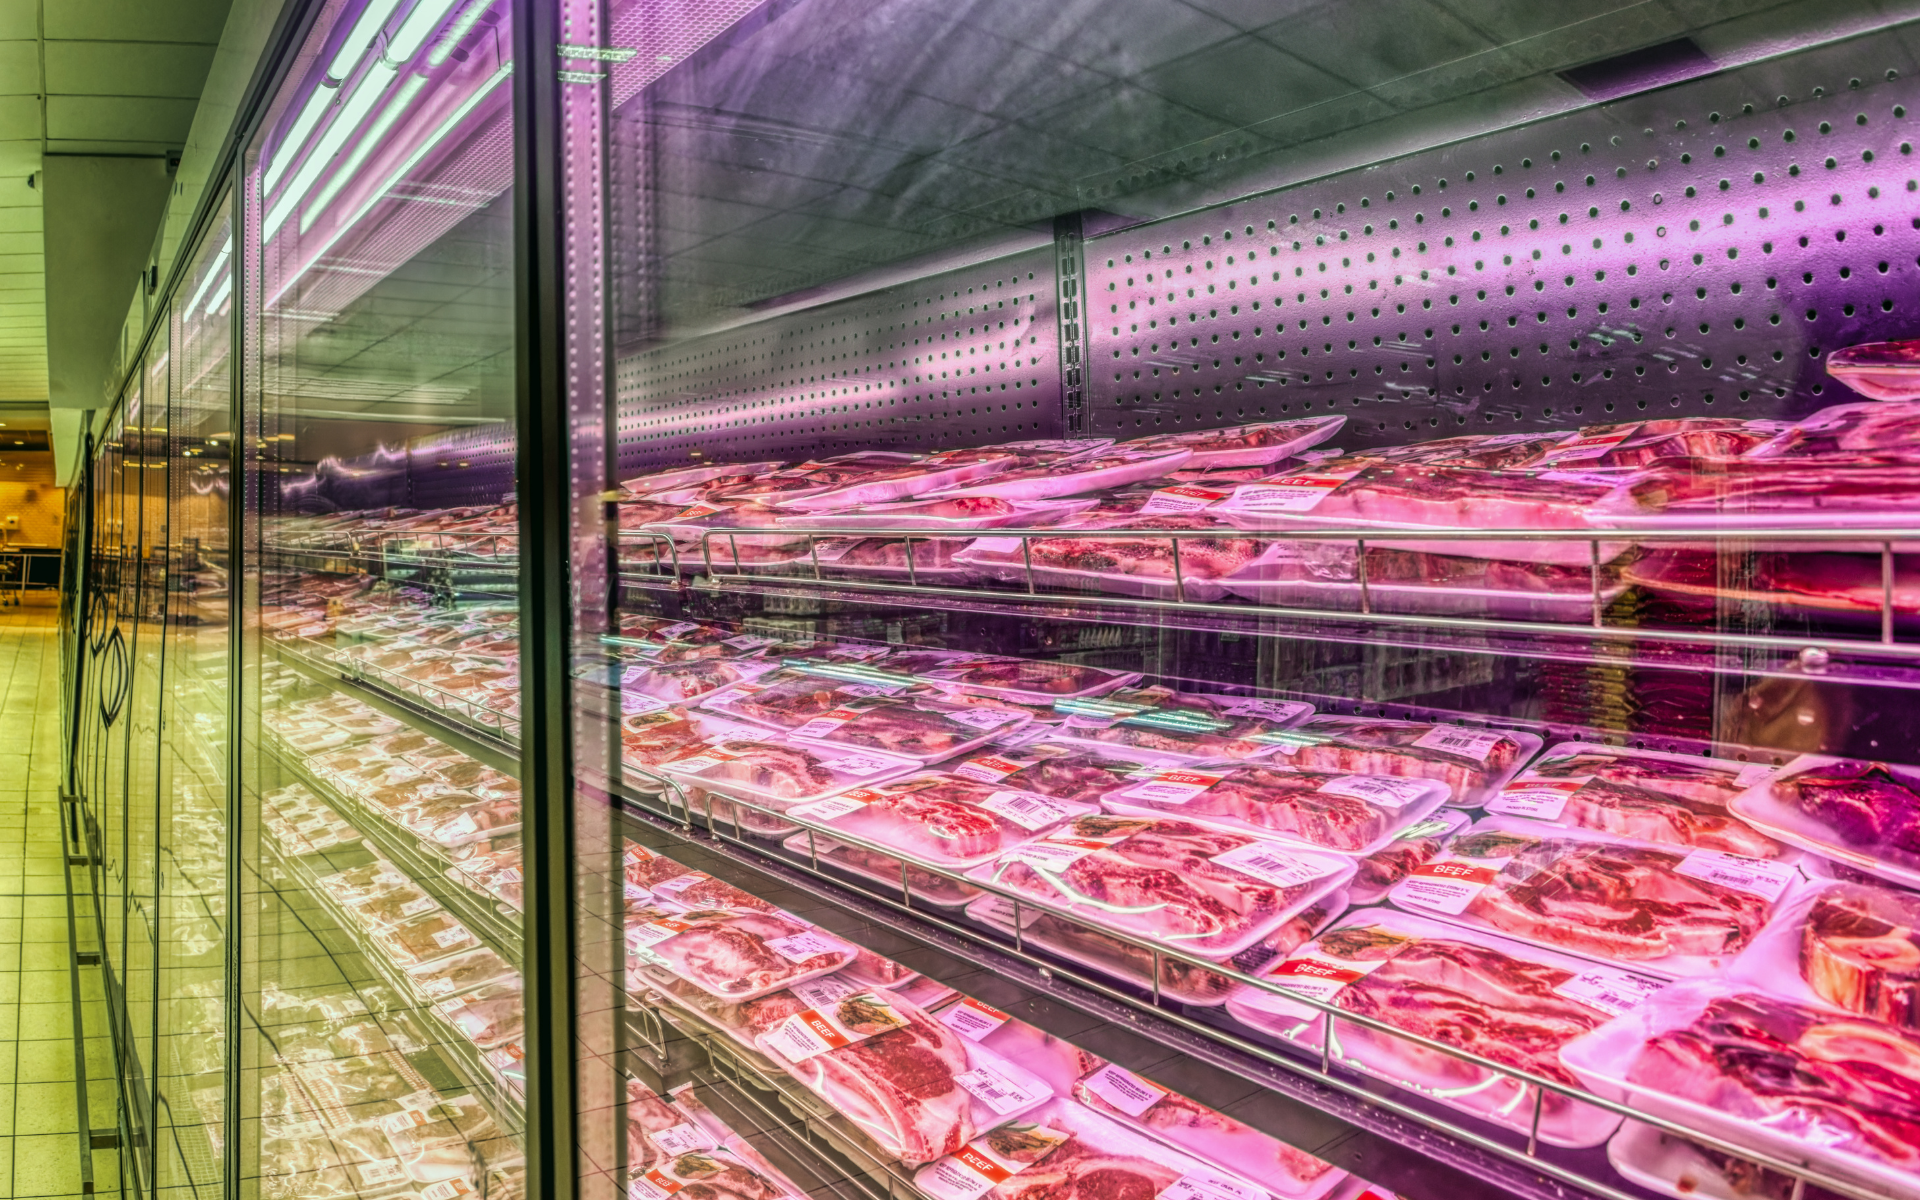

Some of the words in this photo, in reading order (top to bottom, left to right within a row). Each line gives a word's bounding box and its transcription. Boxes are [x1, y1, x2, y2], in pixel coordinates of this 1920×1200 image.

[1167, 774, 1201, 782] BEEF
[1433, 864, 1474, 876] BEEF
[1294, 963, 1337, 976] BEEF
[811, 1020, 836, 1038] BEEF
[962, 1152, 994, 1171] BEEF
